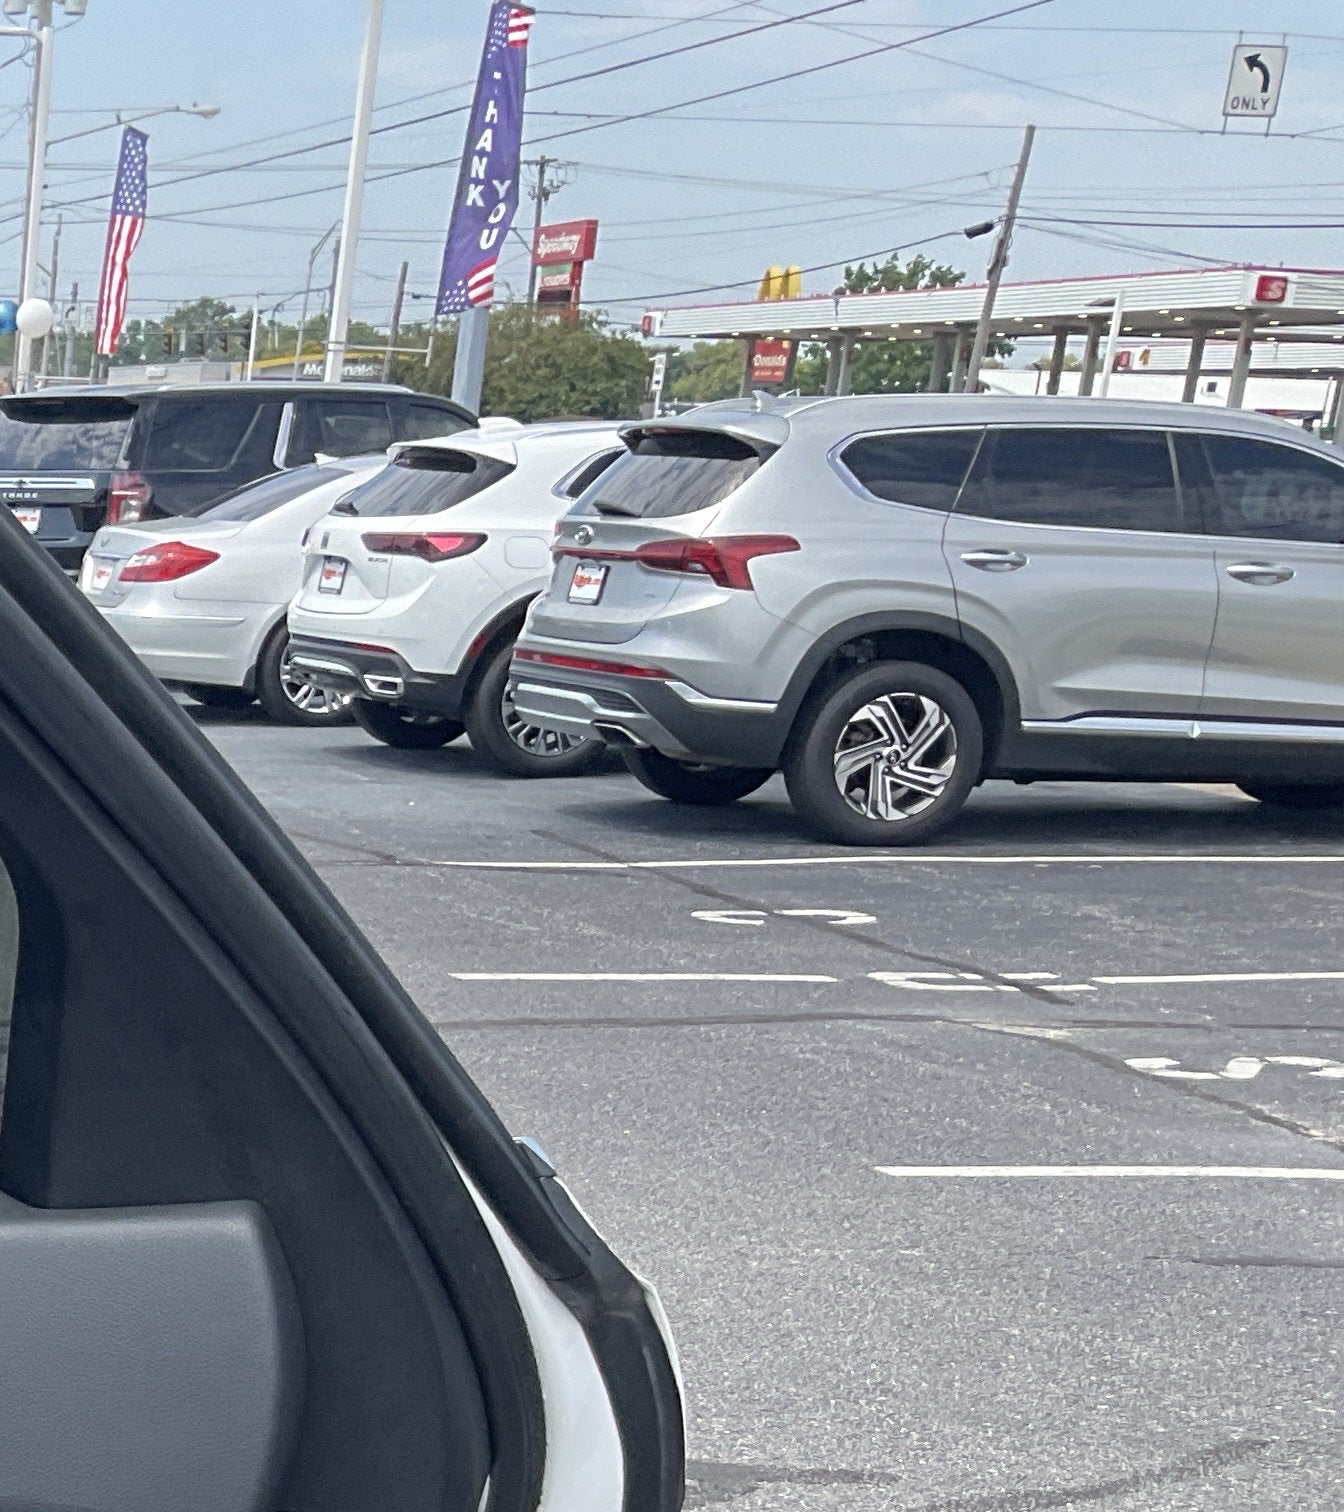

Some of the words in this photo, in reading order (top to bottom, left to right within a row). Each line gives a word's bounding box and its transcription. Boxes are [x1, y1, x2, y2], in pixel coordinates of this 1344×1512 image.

[1230, 96, 1271, 111] ONLY
[479, 179, 512, 250] YOU
[537, 233, 581, 258] Speedway
